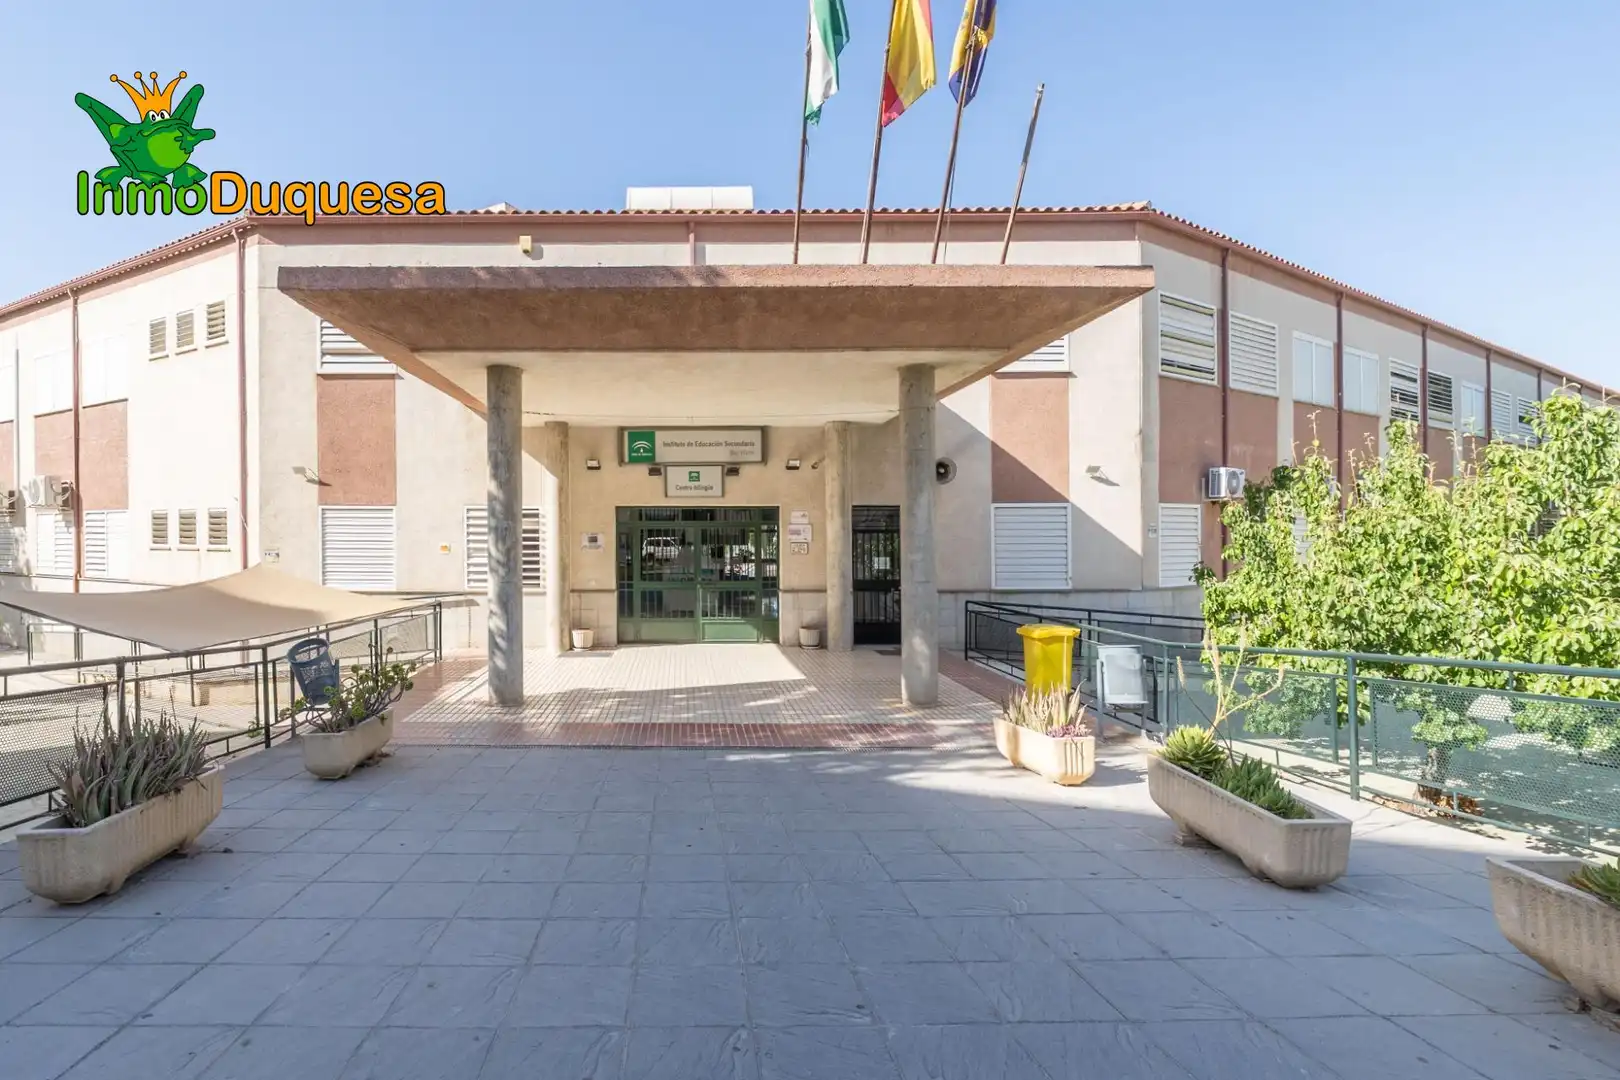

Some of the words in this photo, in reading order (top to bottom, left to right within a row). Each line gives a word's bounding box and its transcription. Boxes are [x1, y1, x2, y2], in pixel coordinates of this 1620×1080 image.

[663, 440, 685, 448] Instituto
[687, 440, 694, 448] de
[694, 440, 723, 448] Educación
